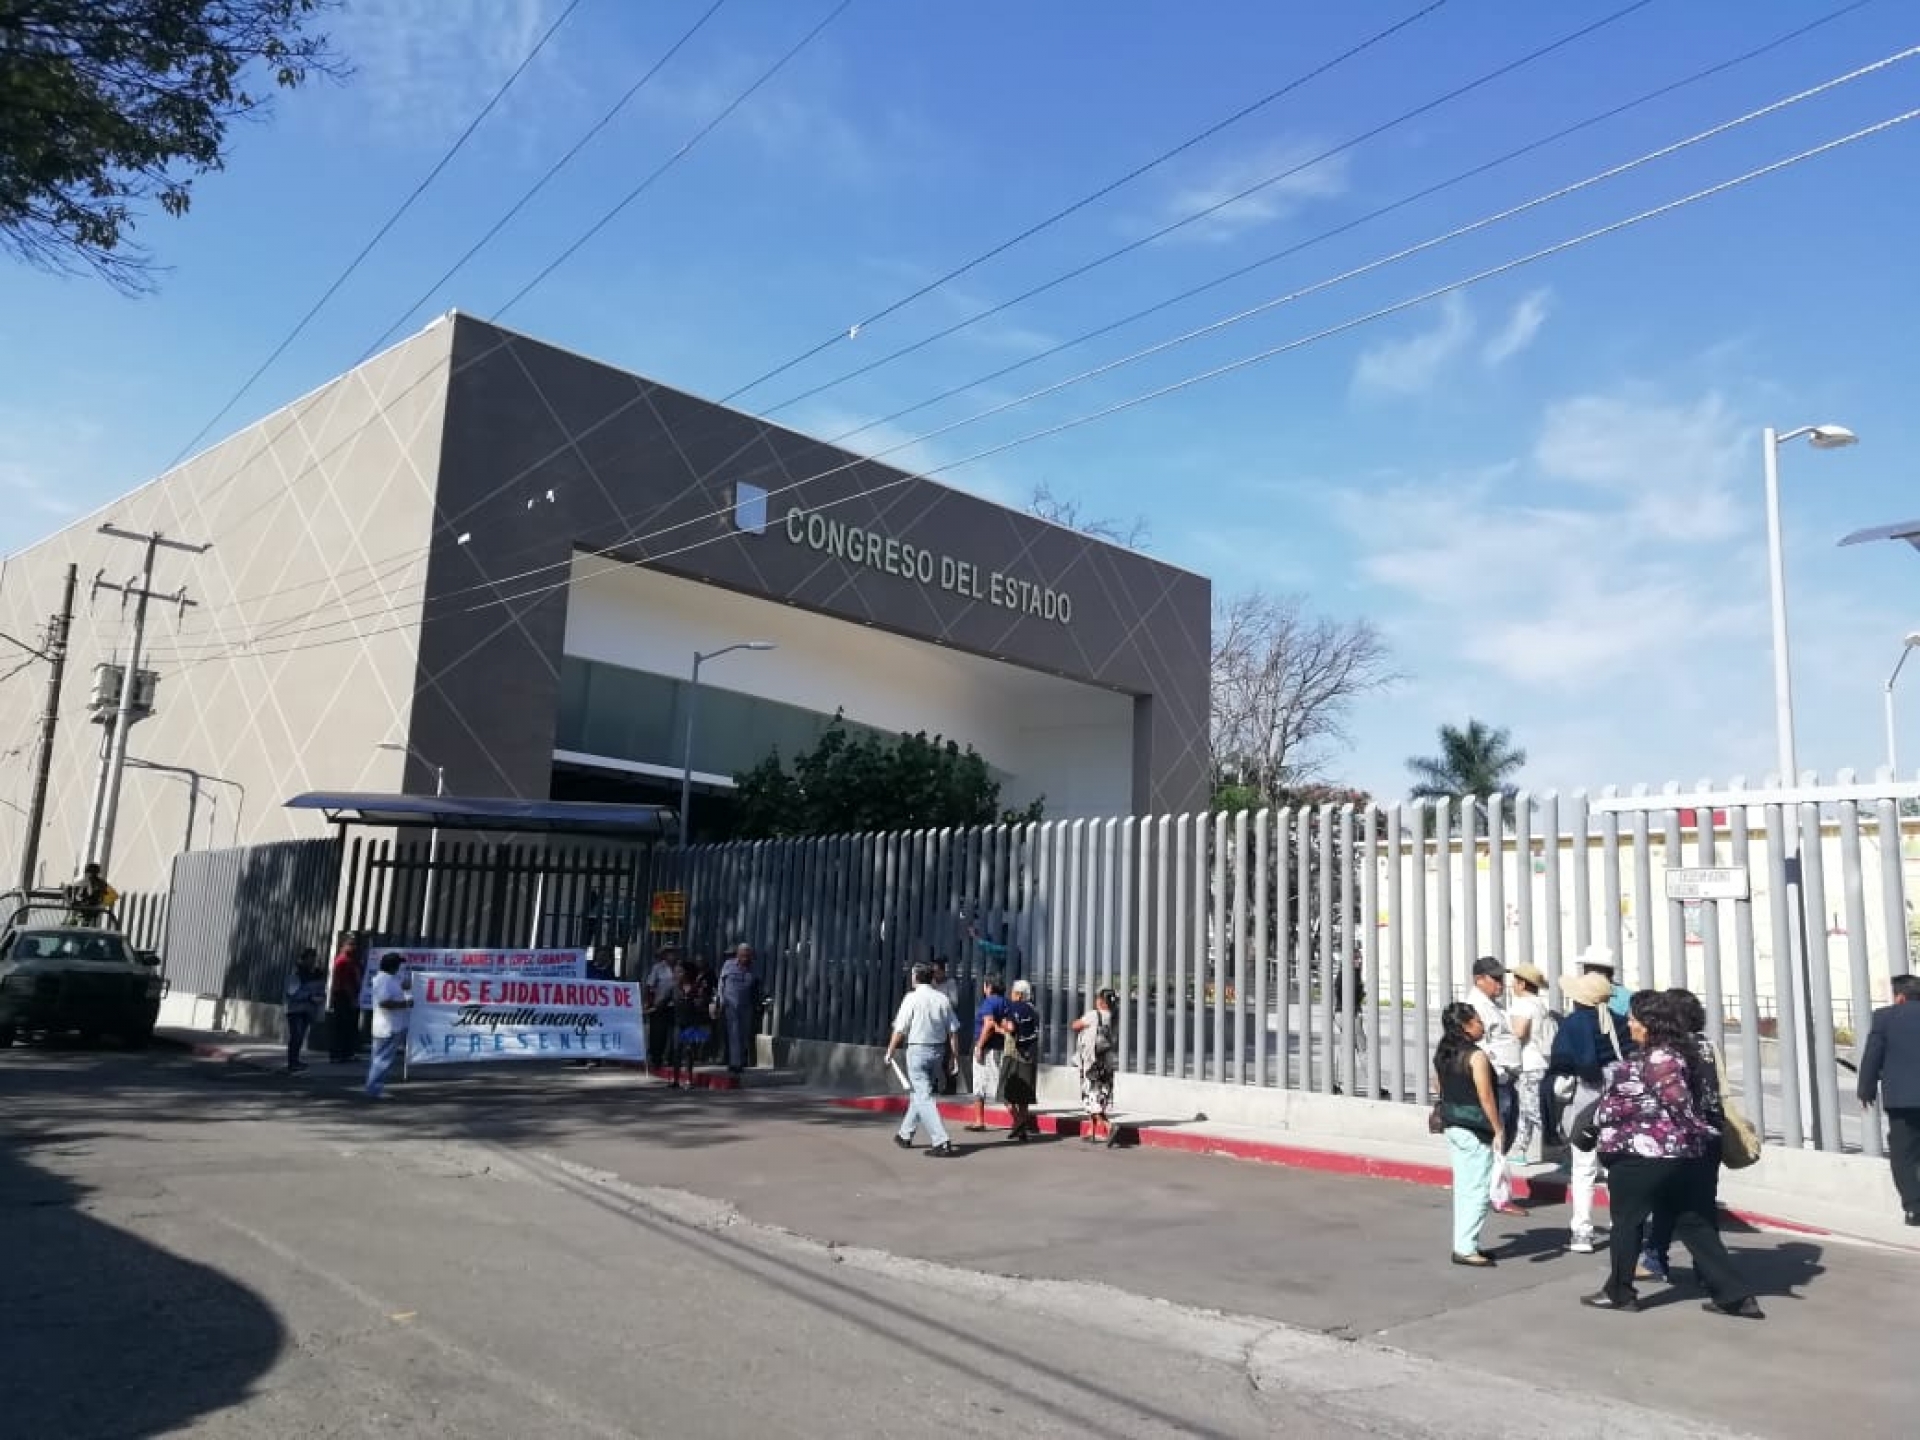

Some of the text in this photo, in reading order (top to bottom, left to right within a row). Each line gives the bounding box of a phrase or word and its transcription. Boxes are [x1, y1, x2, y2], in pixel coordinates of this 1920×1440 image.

[786, 507, 1072, 624] CONGRESO DEL ESTADO
[426, 978, 472, 1004] LOS
[614, 986, 633, 1007] DE
